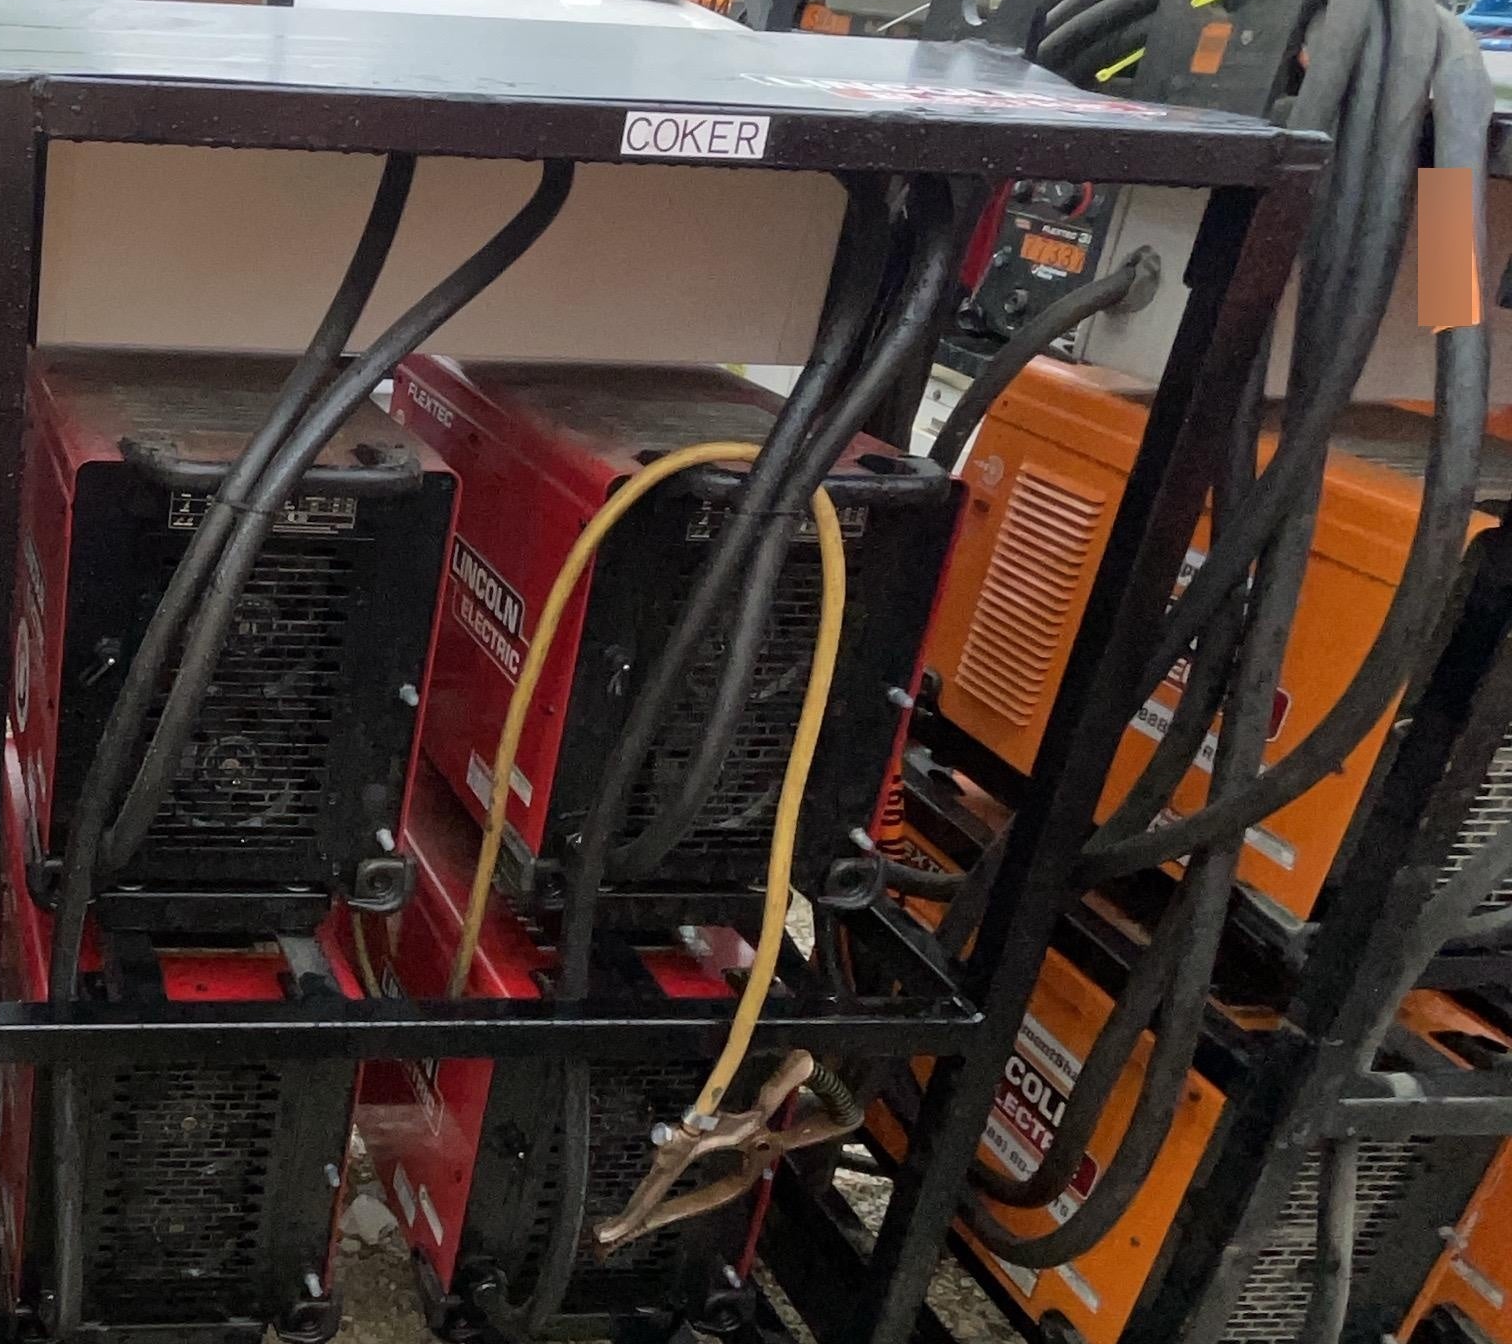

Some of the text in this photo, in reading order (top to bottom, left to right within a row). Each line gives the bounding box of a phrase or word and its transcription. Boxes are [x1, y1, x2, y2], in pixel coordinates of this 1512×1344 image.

[626, 117, 760, 155] COKER
[407, 381, 455, 429] FLEXTEC
[451, 541, 519, 635] LINCOLN
[459, 592, 521, 677] ELECTRIC
